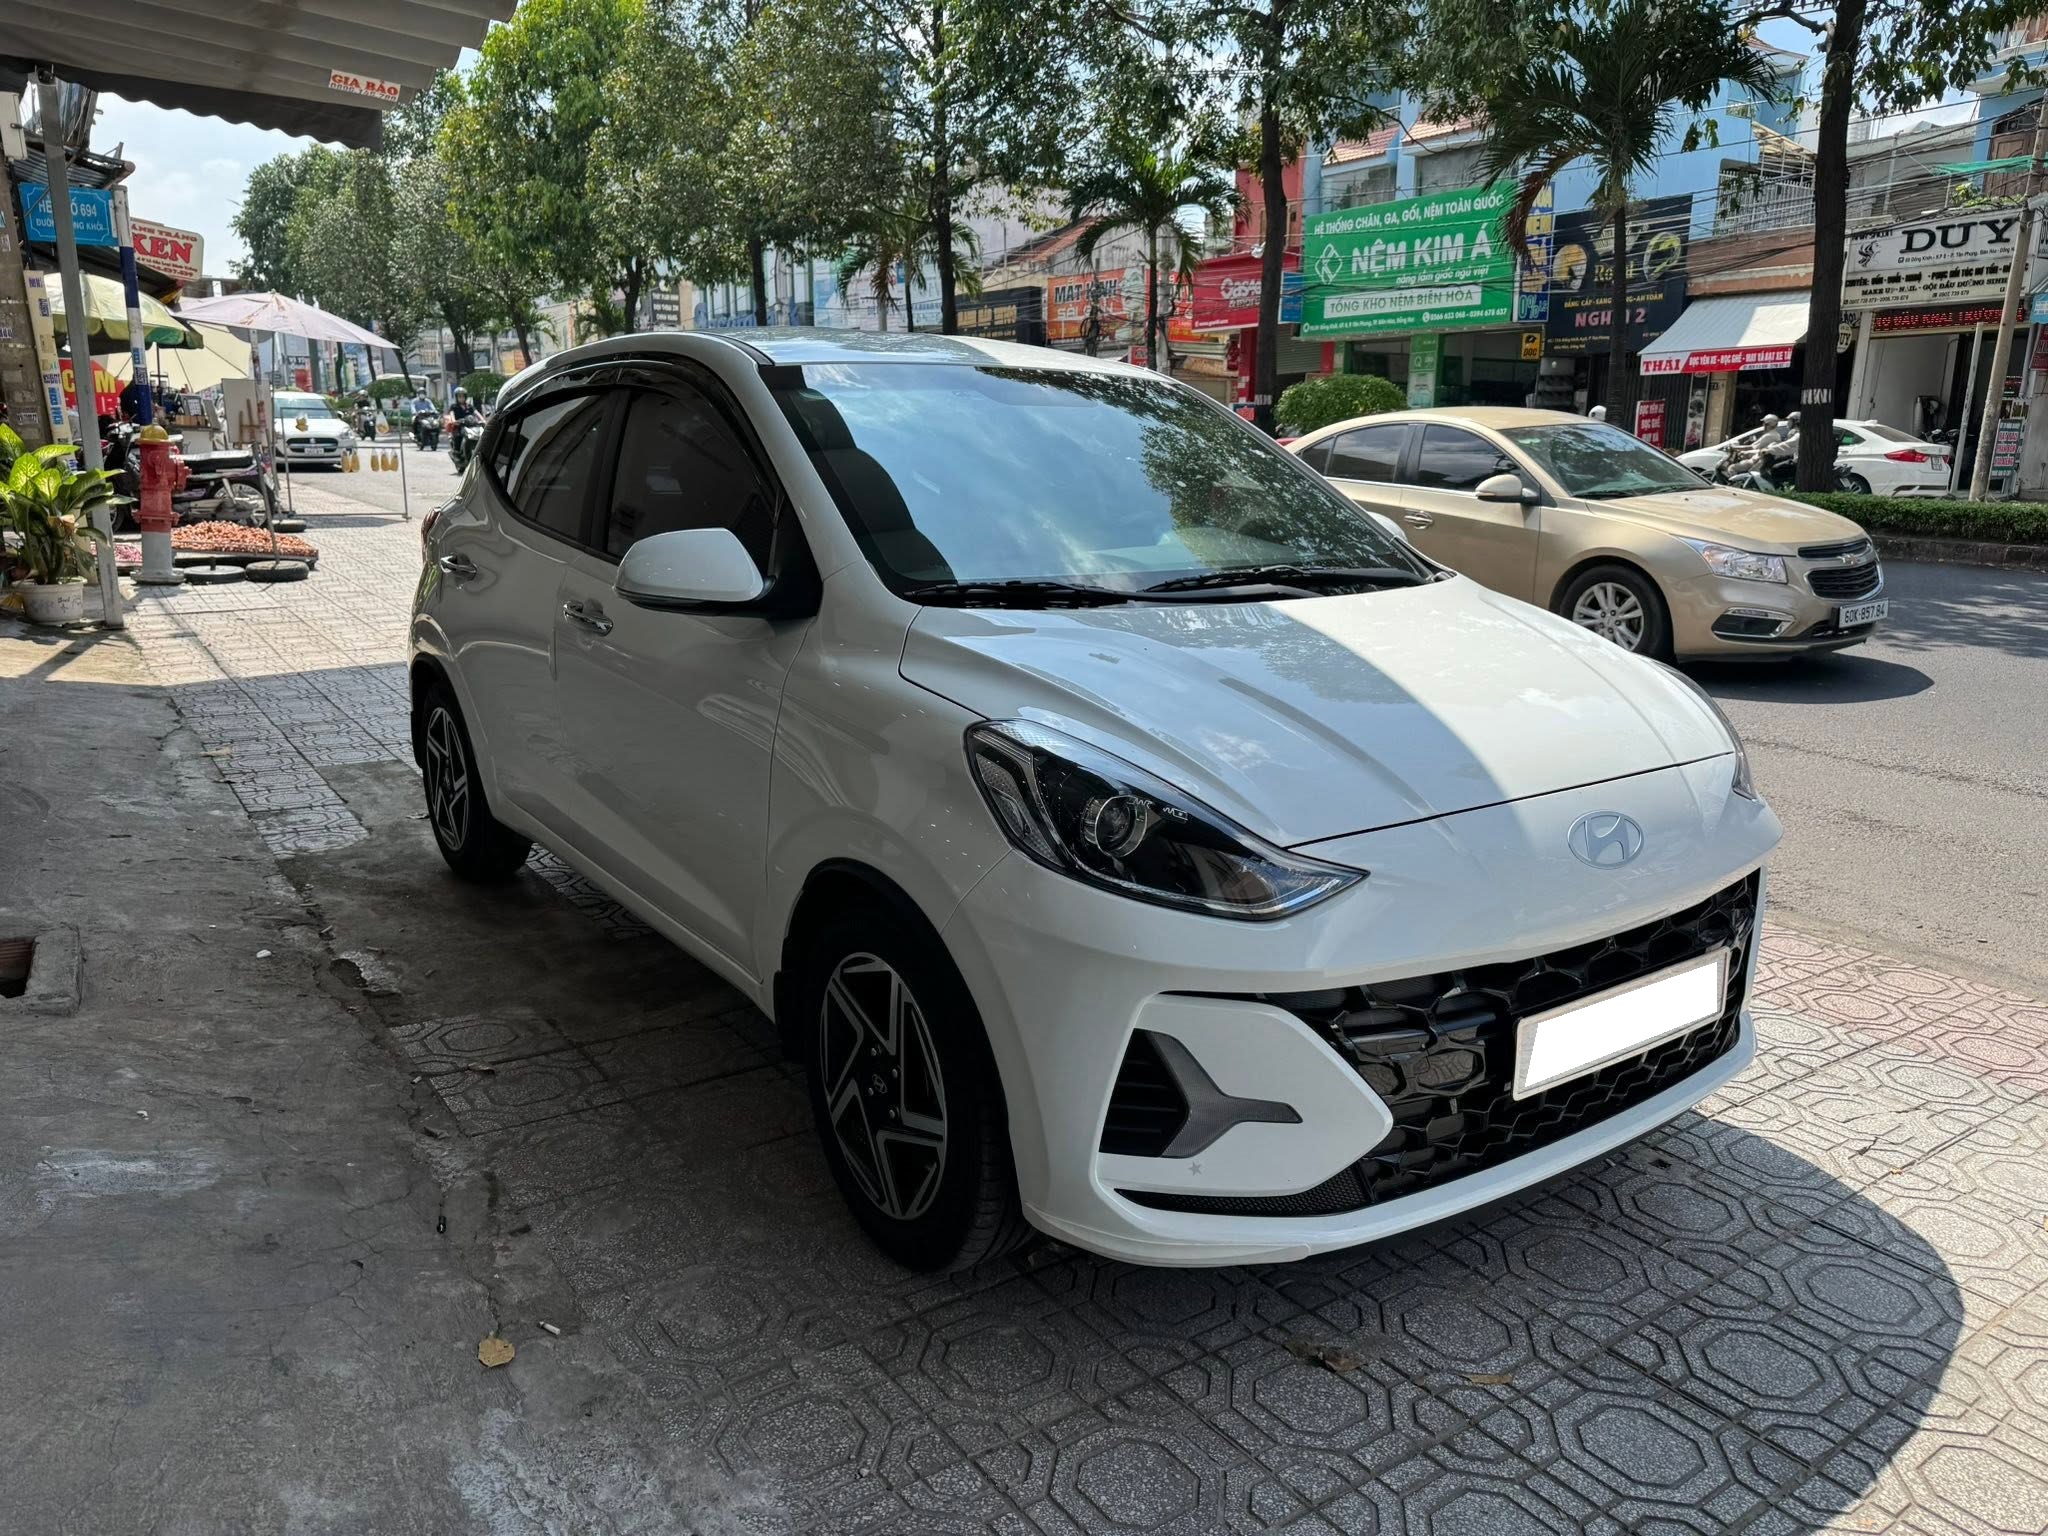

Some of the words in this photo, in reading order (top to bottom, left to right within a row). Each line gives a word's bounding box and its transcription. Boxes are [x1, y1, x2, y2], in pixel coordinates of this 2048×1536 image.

[331, 73, 360, 89] GIA
[366, 80, 399, 96] BẢO
[80, 203, 97, 217] 694
[1326, 216, 1353, 235] THỐNG
[1384, 212, 1400, 226] GA,
[1424, 201, 1443, 219] NỆM
[1445, 198, 1471, 215] TOÀN
[132, 231, 193, 264] KEN
[1899, 217, 2019, 254] DUY
[1352, 238, 1406, 278] NỆM
[1414, 231, 1464, 268] KIM
[1471, 222, 1492, 261] Á
[1086, 279, 1118, 300] KNH
[1330, 296, 1359, 313] TỔNG
[1363, 296, 1386, 311] KHO
[1417, 289, 1442, 305] BIÊN
[1635, 308, 1647, 323] 2
[63, 369, 117, 394] CM
